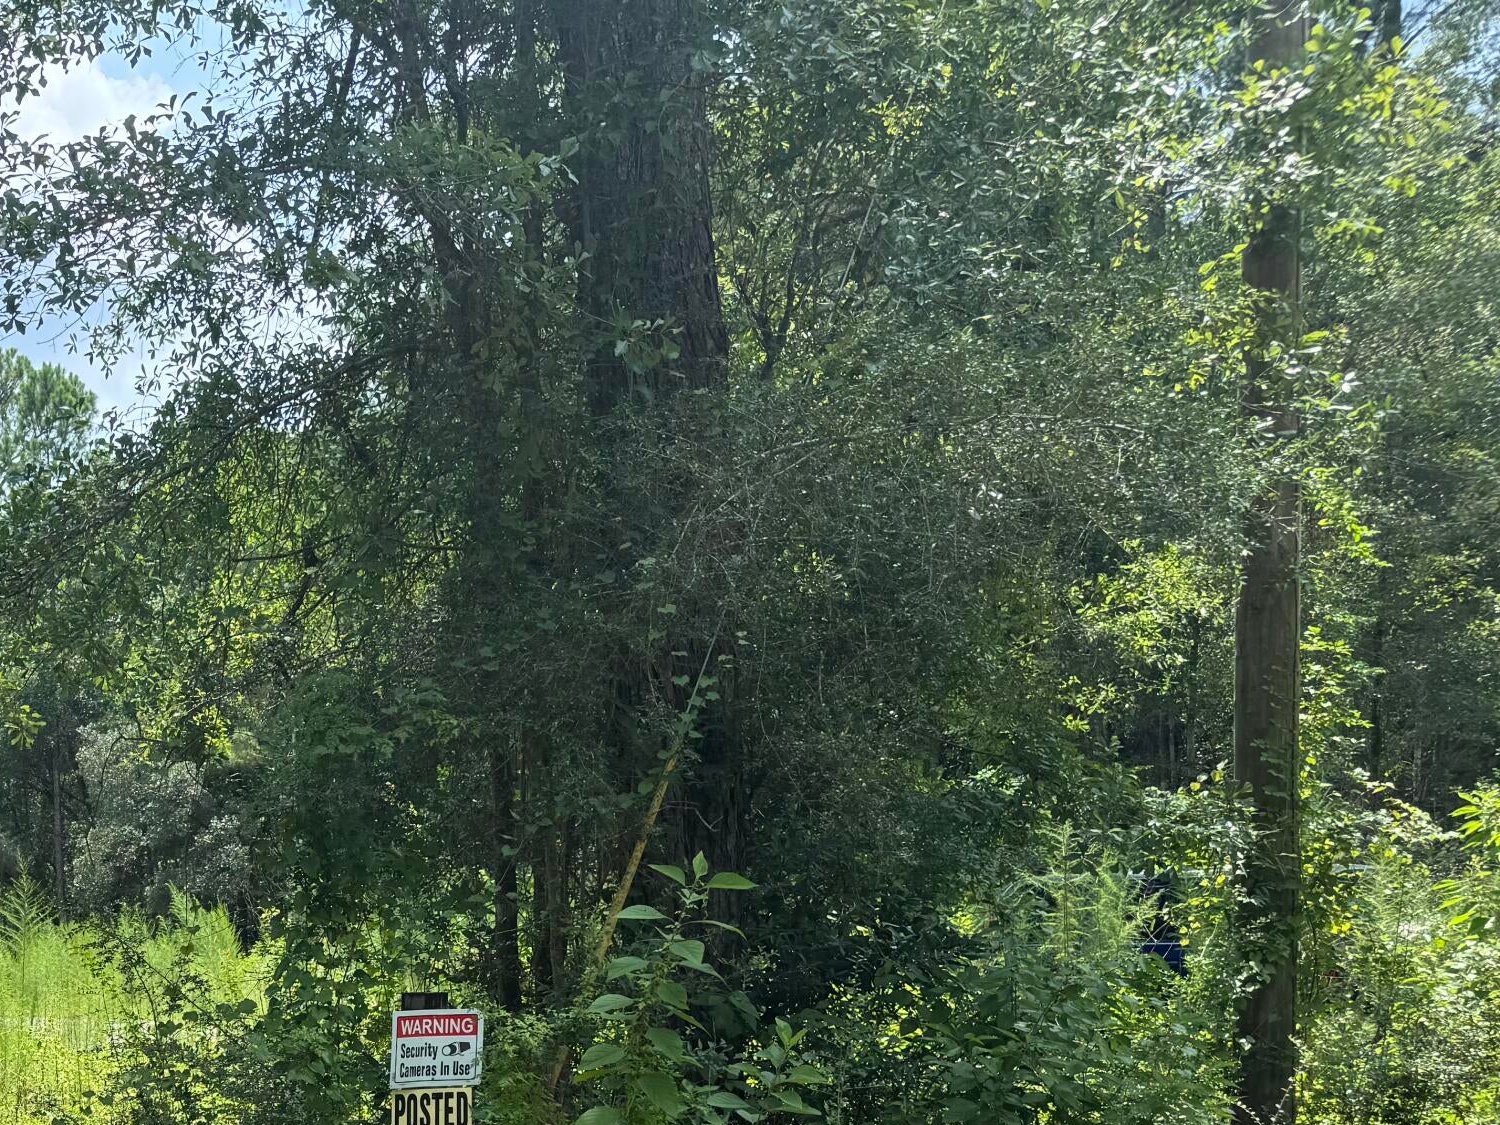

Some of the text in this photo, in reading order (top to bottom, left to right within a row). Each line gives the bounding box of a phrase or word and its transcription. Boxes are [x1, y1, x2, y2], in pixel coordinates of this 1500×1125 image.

[401, 1018, 474, 1035] WARNING
[400, 1042, 438, 1060] Security
[400, 1061, 470, 1078] Cameras In Use
